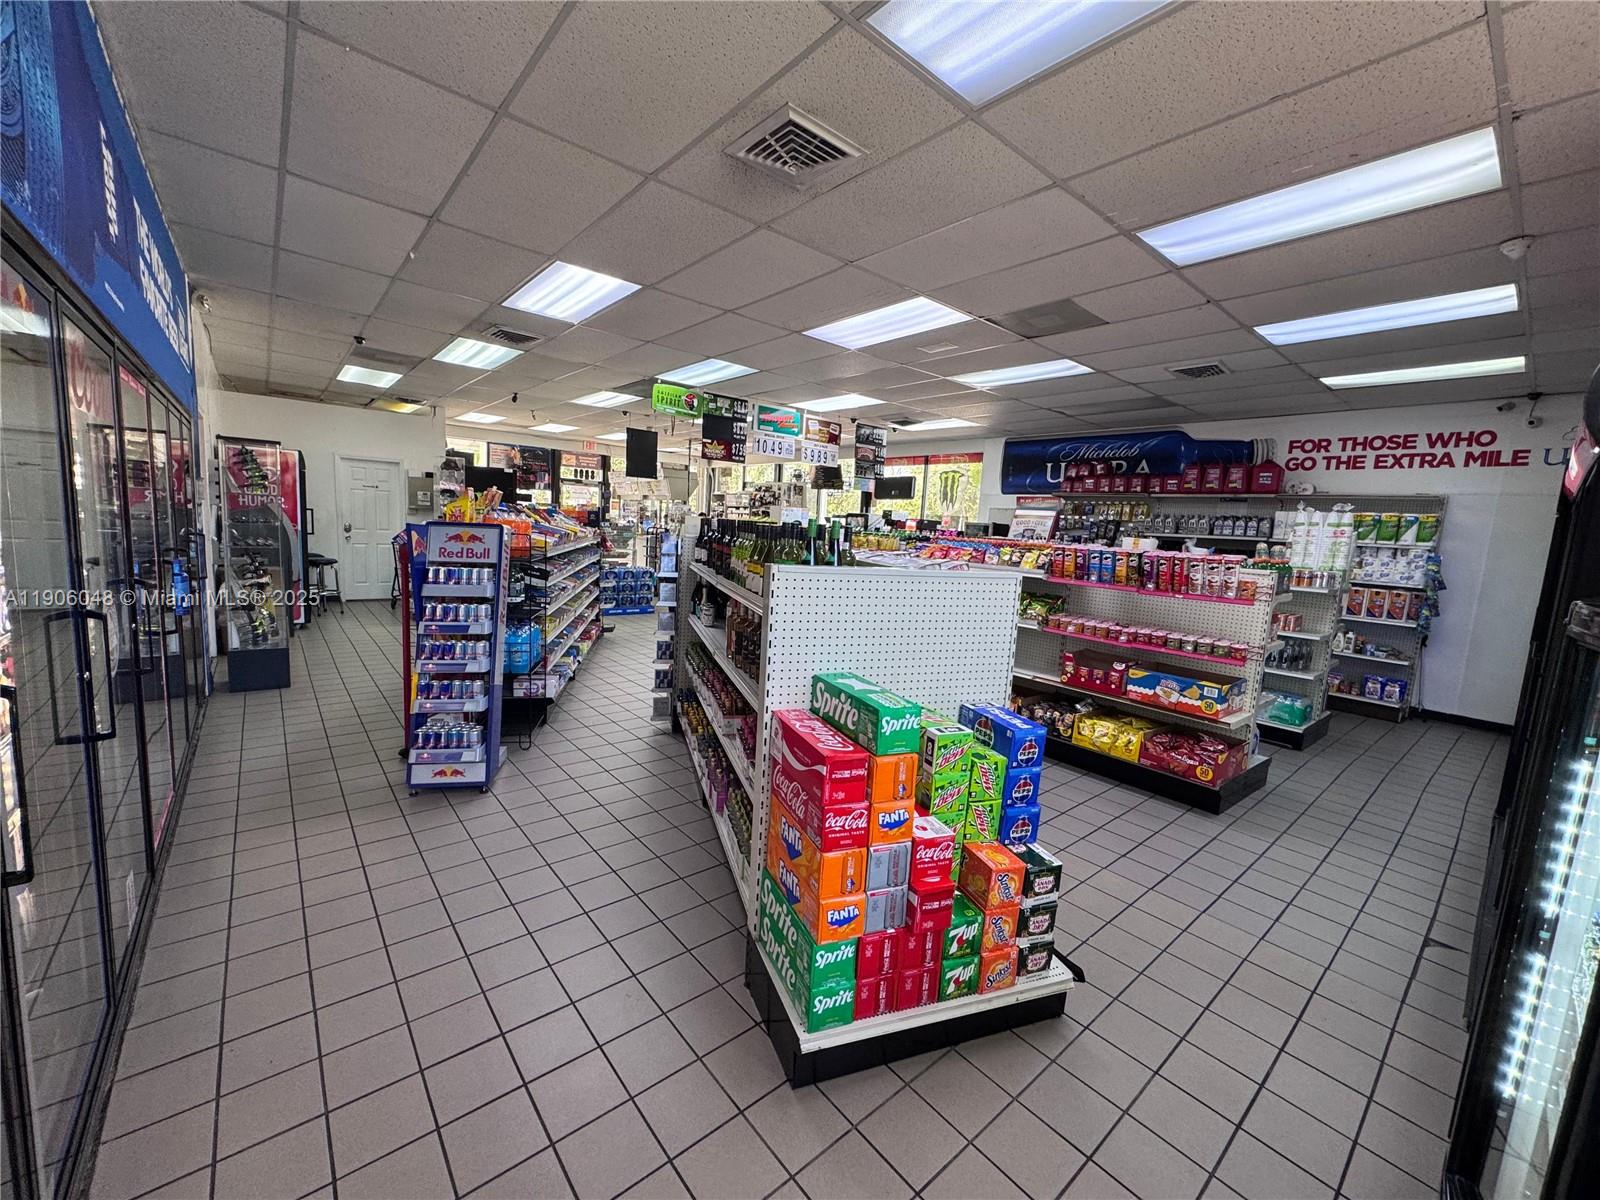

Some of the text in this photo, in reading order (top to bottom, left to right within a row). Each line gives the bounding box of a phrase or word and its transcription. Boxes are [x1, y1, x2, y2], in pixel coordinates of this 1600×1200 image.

[656, 395, 680, 408] SPIRIT
[1060, 442, 1140, 461] Michelob
[1287, 429, 1498, 454] FOR THOSE WHO
[1285, 449, 1531, 471] GO THE EXTRA MILE
[438, 547, 490, 559] Red Bull
[813, 682, 859, 730] Sprite
[1204, 701, 1214, 709] 50
[881, 714, 920, 736] Sprite
[1200, 767, 1210, 775] 50
[773, 764, 808, 819] Coca-Cola
[878, 809, 909, 825] FANTA
[997, 873, 1014, 901] Sunkist
[761, 869, 798, 948] Sprite
[827, 905, 860, 923] FANTA
[991, 917, 1008, 943] Sunkist
[761, 917, 797, 991] Sprite
[815, 944, 856, 969] Sprite
[985, 960, 1012, 988] Sunkist
[813, 989, 854, 1014] Sprite
